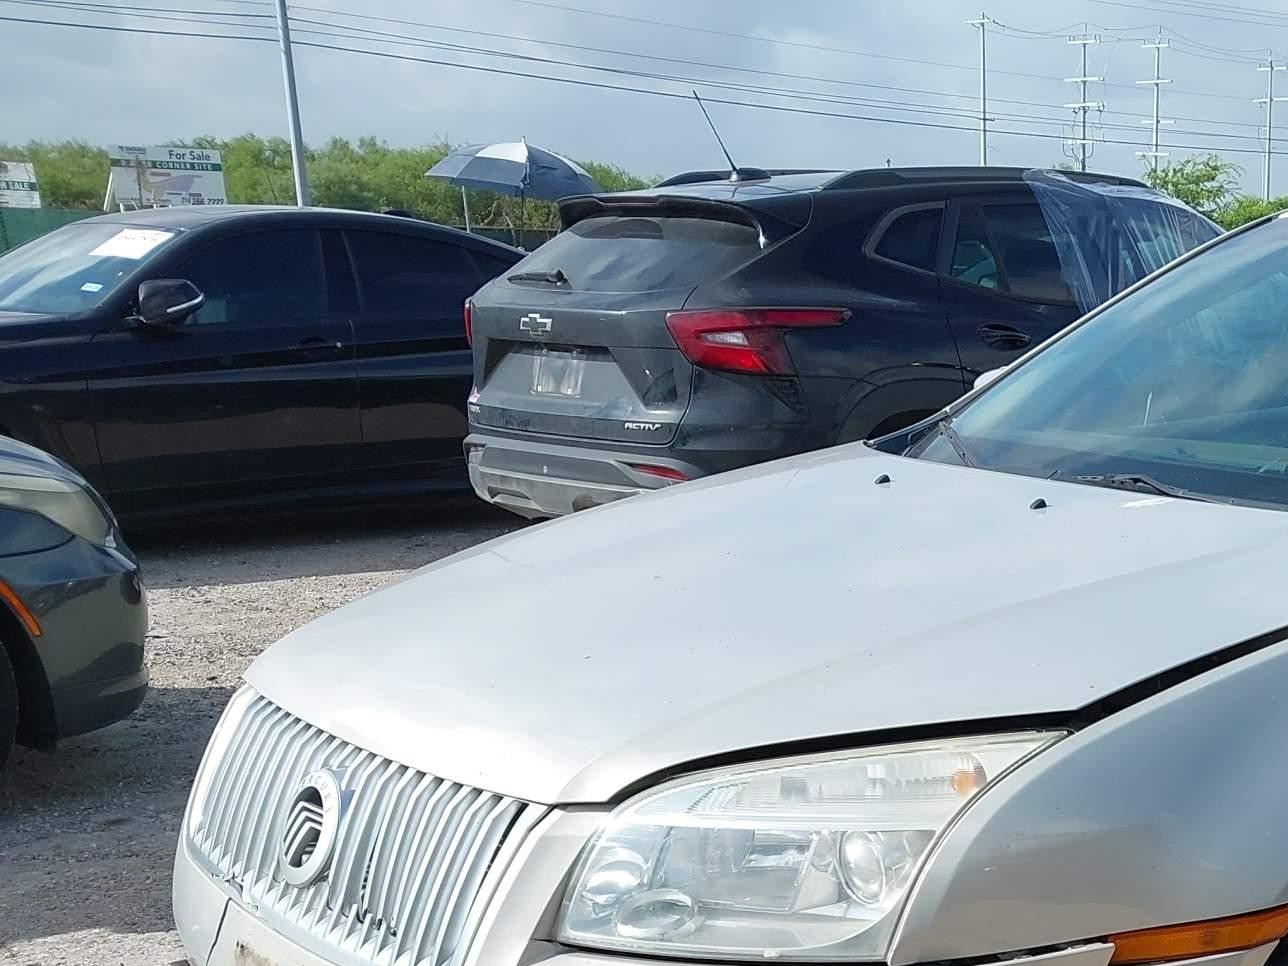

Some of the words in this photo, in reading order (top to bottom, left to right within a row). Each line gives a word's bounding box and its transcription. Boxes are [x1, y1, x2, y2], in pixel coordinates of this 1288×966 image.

[168, 150, 187, 161] For
[189, 150, 211, 162] Sale
[156, 161, 192, 170] CORNER
[194, 163, 212, 171] SITE
